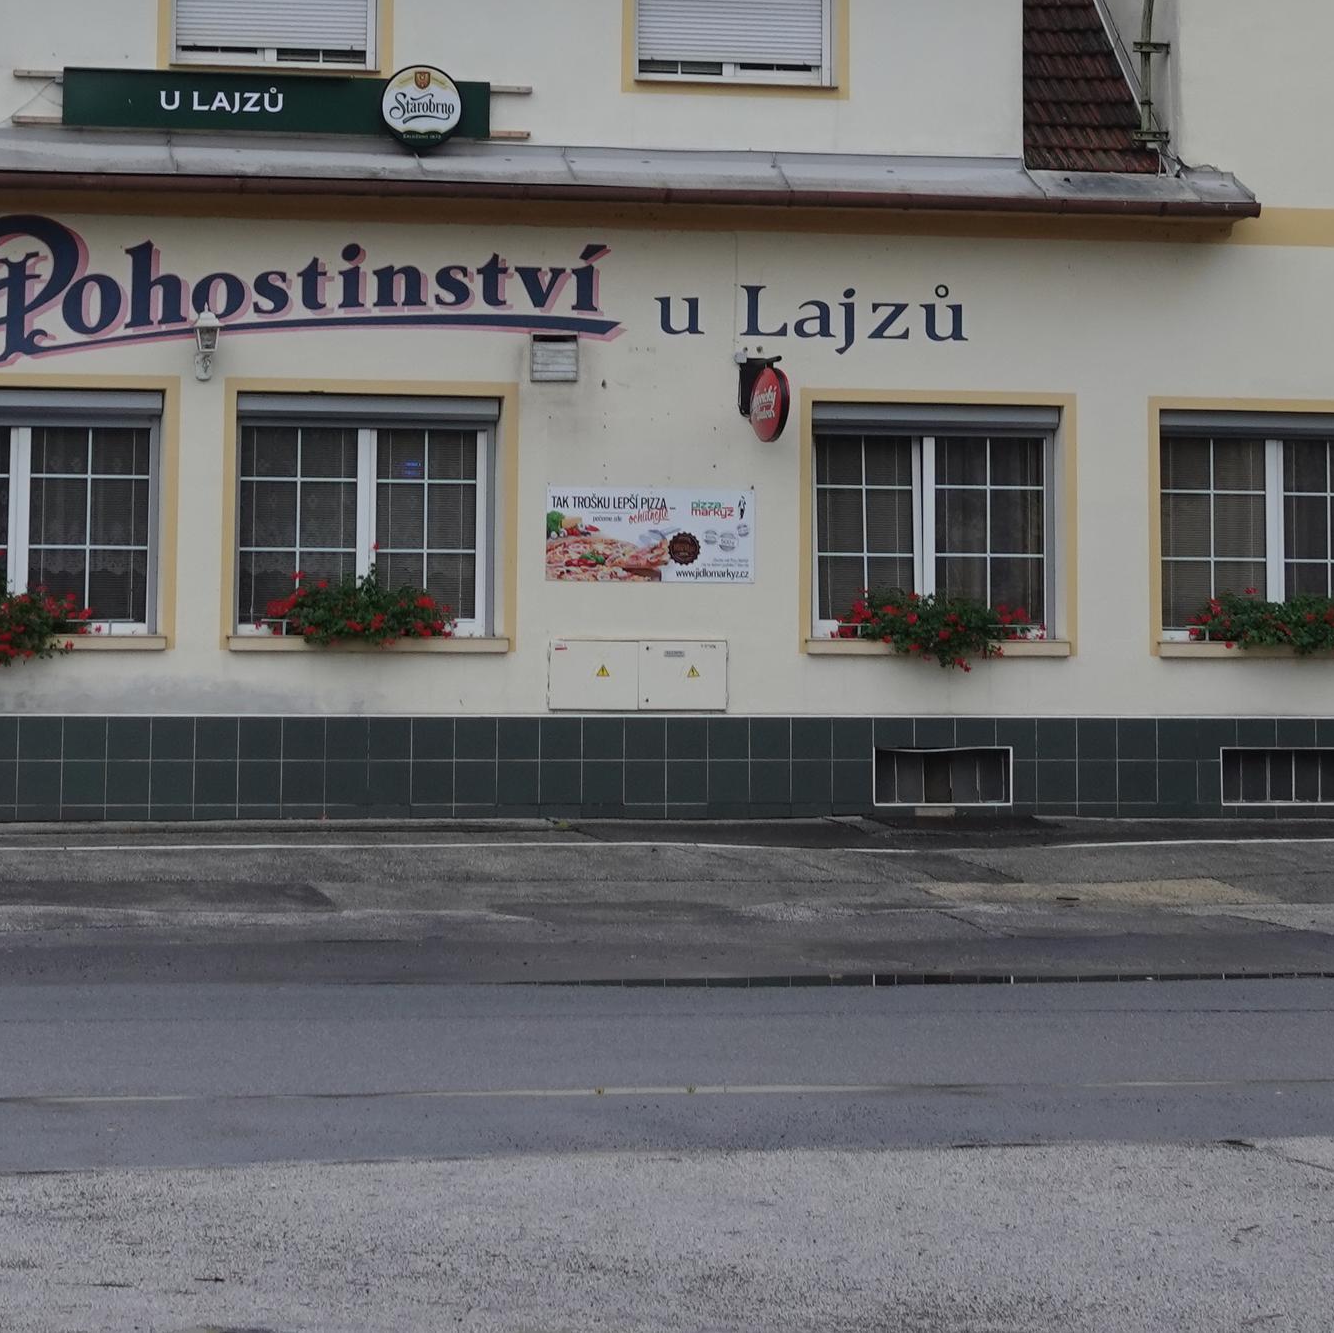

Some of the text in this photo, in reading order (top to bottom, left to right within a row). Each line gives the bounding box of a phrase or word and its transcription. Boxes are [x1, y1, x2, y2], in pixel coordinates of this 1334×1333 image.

[160, 87, 284, 113] U LAJZŮ
[389, 92, 455, 122] Starobrno
[654, 283, 969, 355] u Lajzů
[551, 496, 569, 509] TAK
[573, 494, 610, 509] TROŠKU
[613, 494, 639, 509] LEPŠÍ
[691, 500, 722, 510] pizza
[676, 568, 749, 580] www.jidlomarkyz.cz
